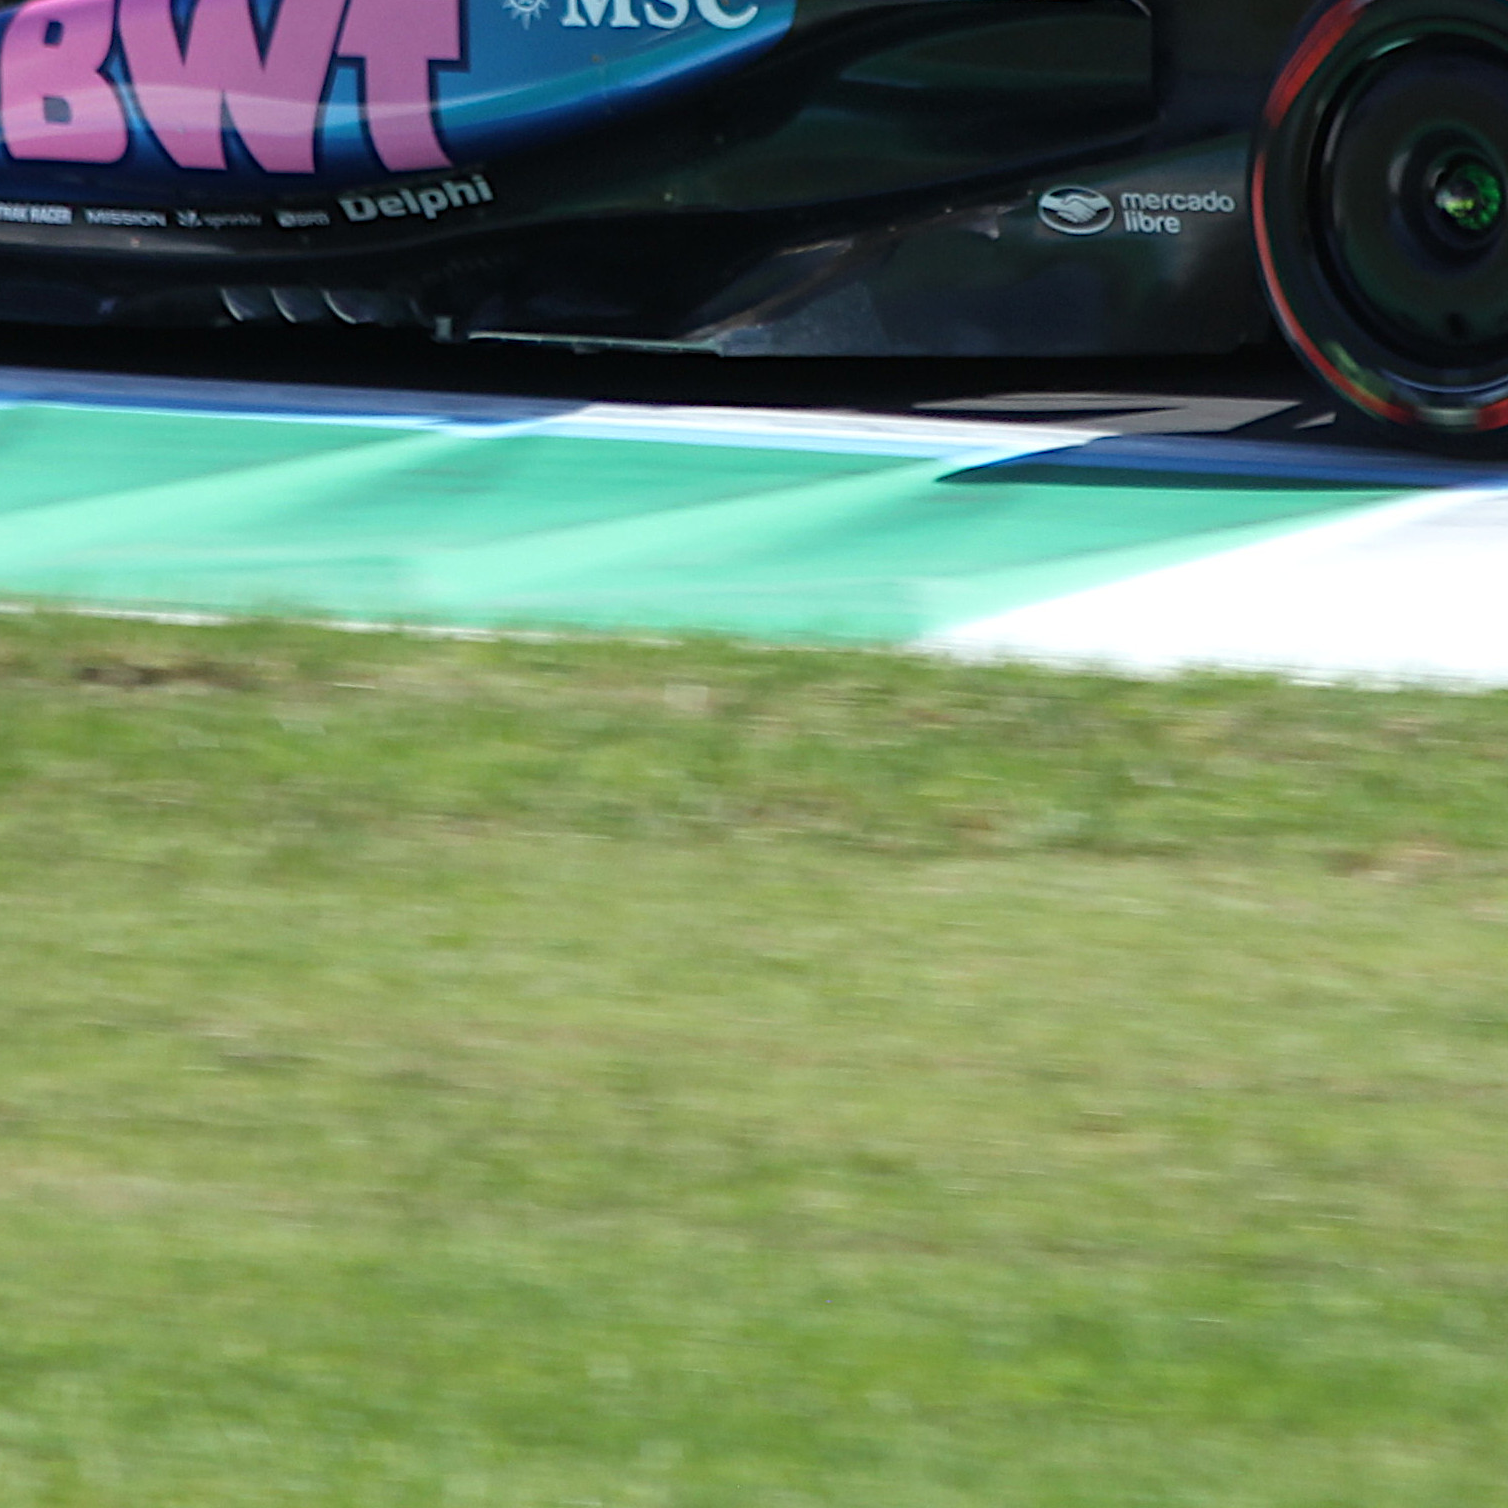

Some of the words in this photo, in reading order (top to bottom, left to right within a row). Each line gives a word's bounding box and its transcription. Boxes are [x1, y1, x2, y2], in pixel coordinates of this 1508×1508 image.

[338, 175, 493, 222] Delphi
[1120, 191, 1235, 212] mercado
[84, 208, 167, 227] MISSION
[1123, 210, 1181, 233] libre
